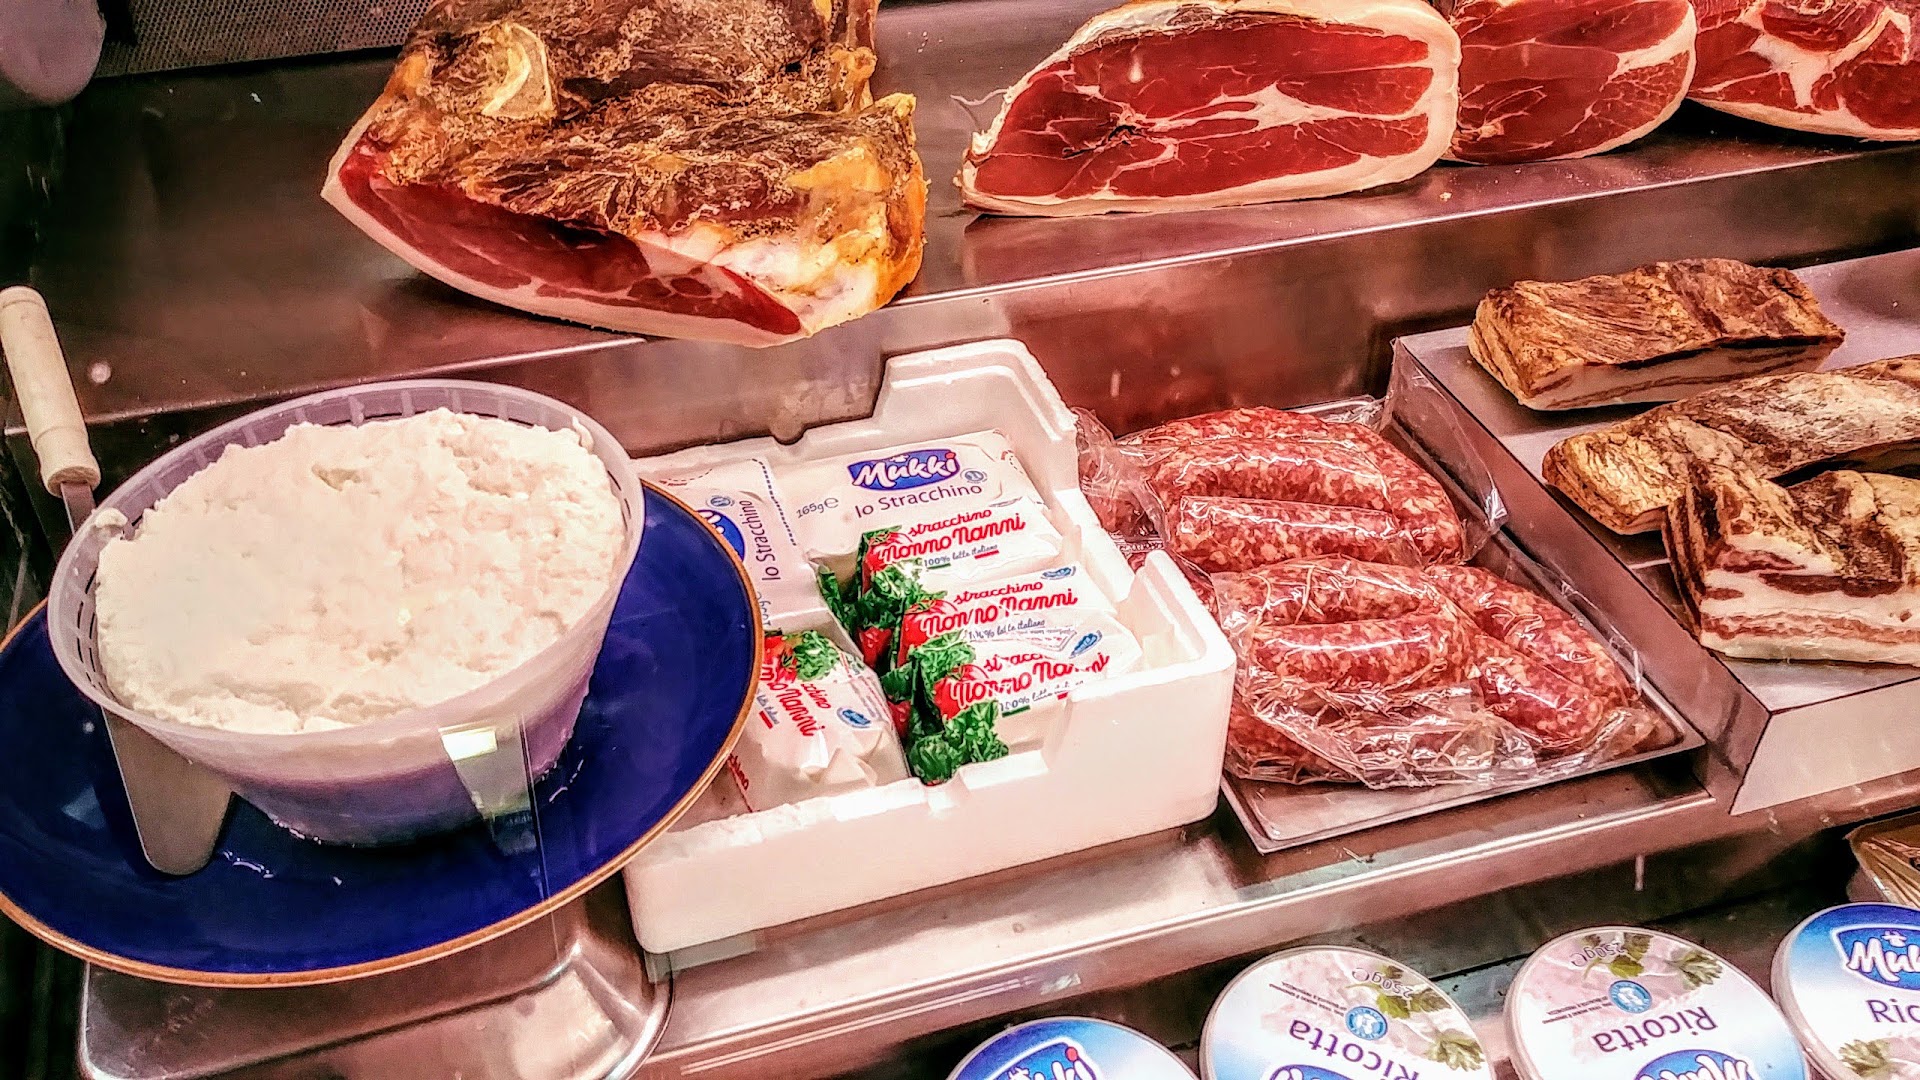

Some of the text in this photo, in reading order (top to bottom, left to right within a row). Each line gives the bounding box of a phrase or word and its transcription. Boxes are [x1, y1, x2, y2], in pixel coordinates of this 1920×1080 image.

[851, 451, 958, 488] Mukki
[878, 483, 982, 511] Stracchino
[739, 500, 776, 562] Stracchino
[908, 509, 992, 537] stracchino
[953, 581, 1044, 605] stracchino
[1592, 1006, 1718, 1053] Ricotta
